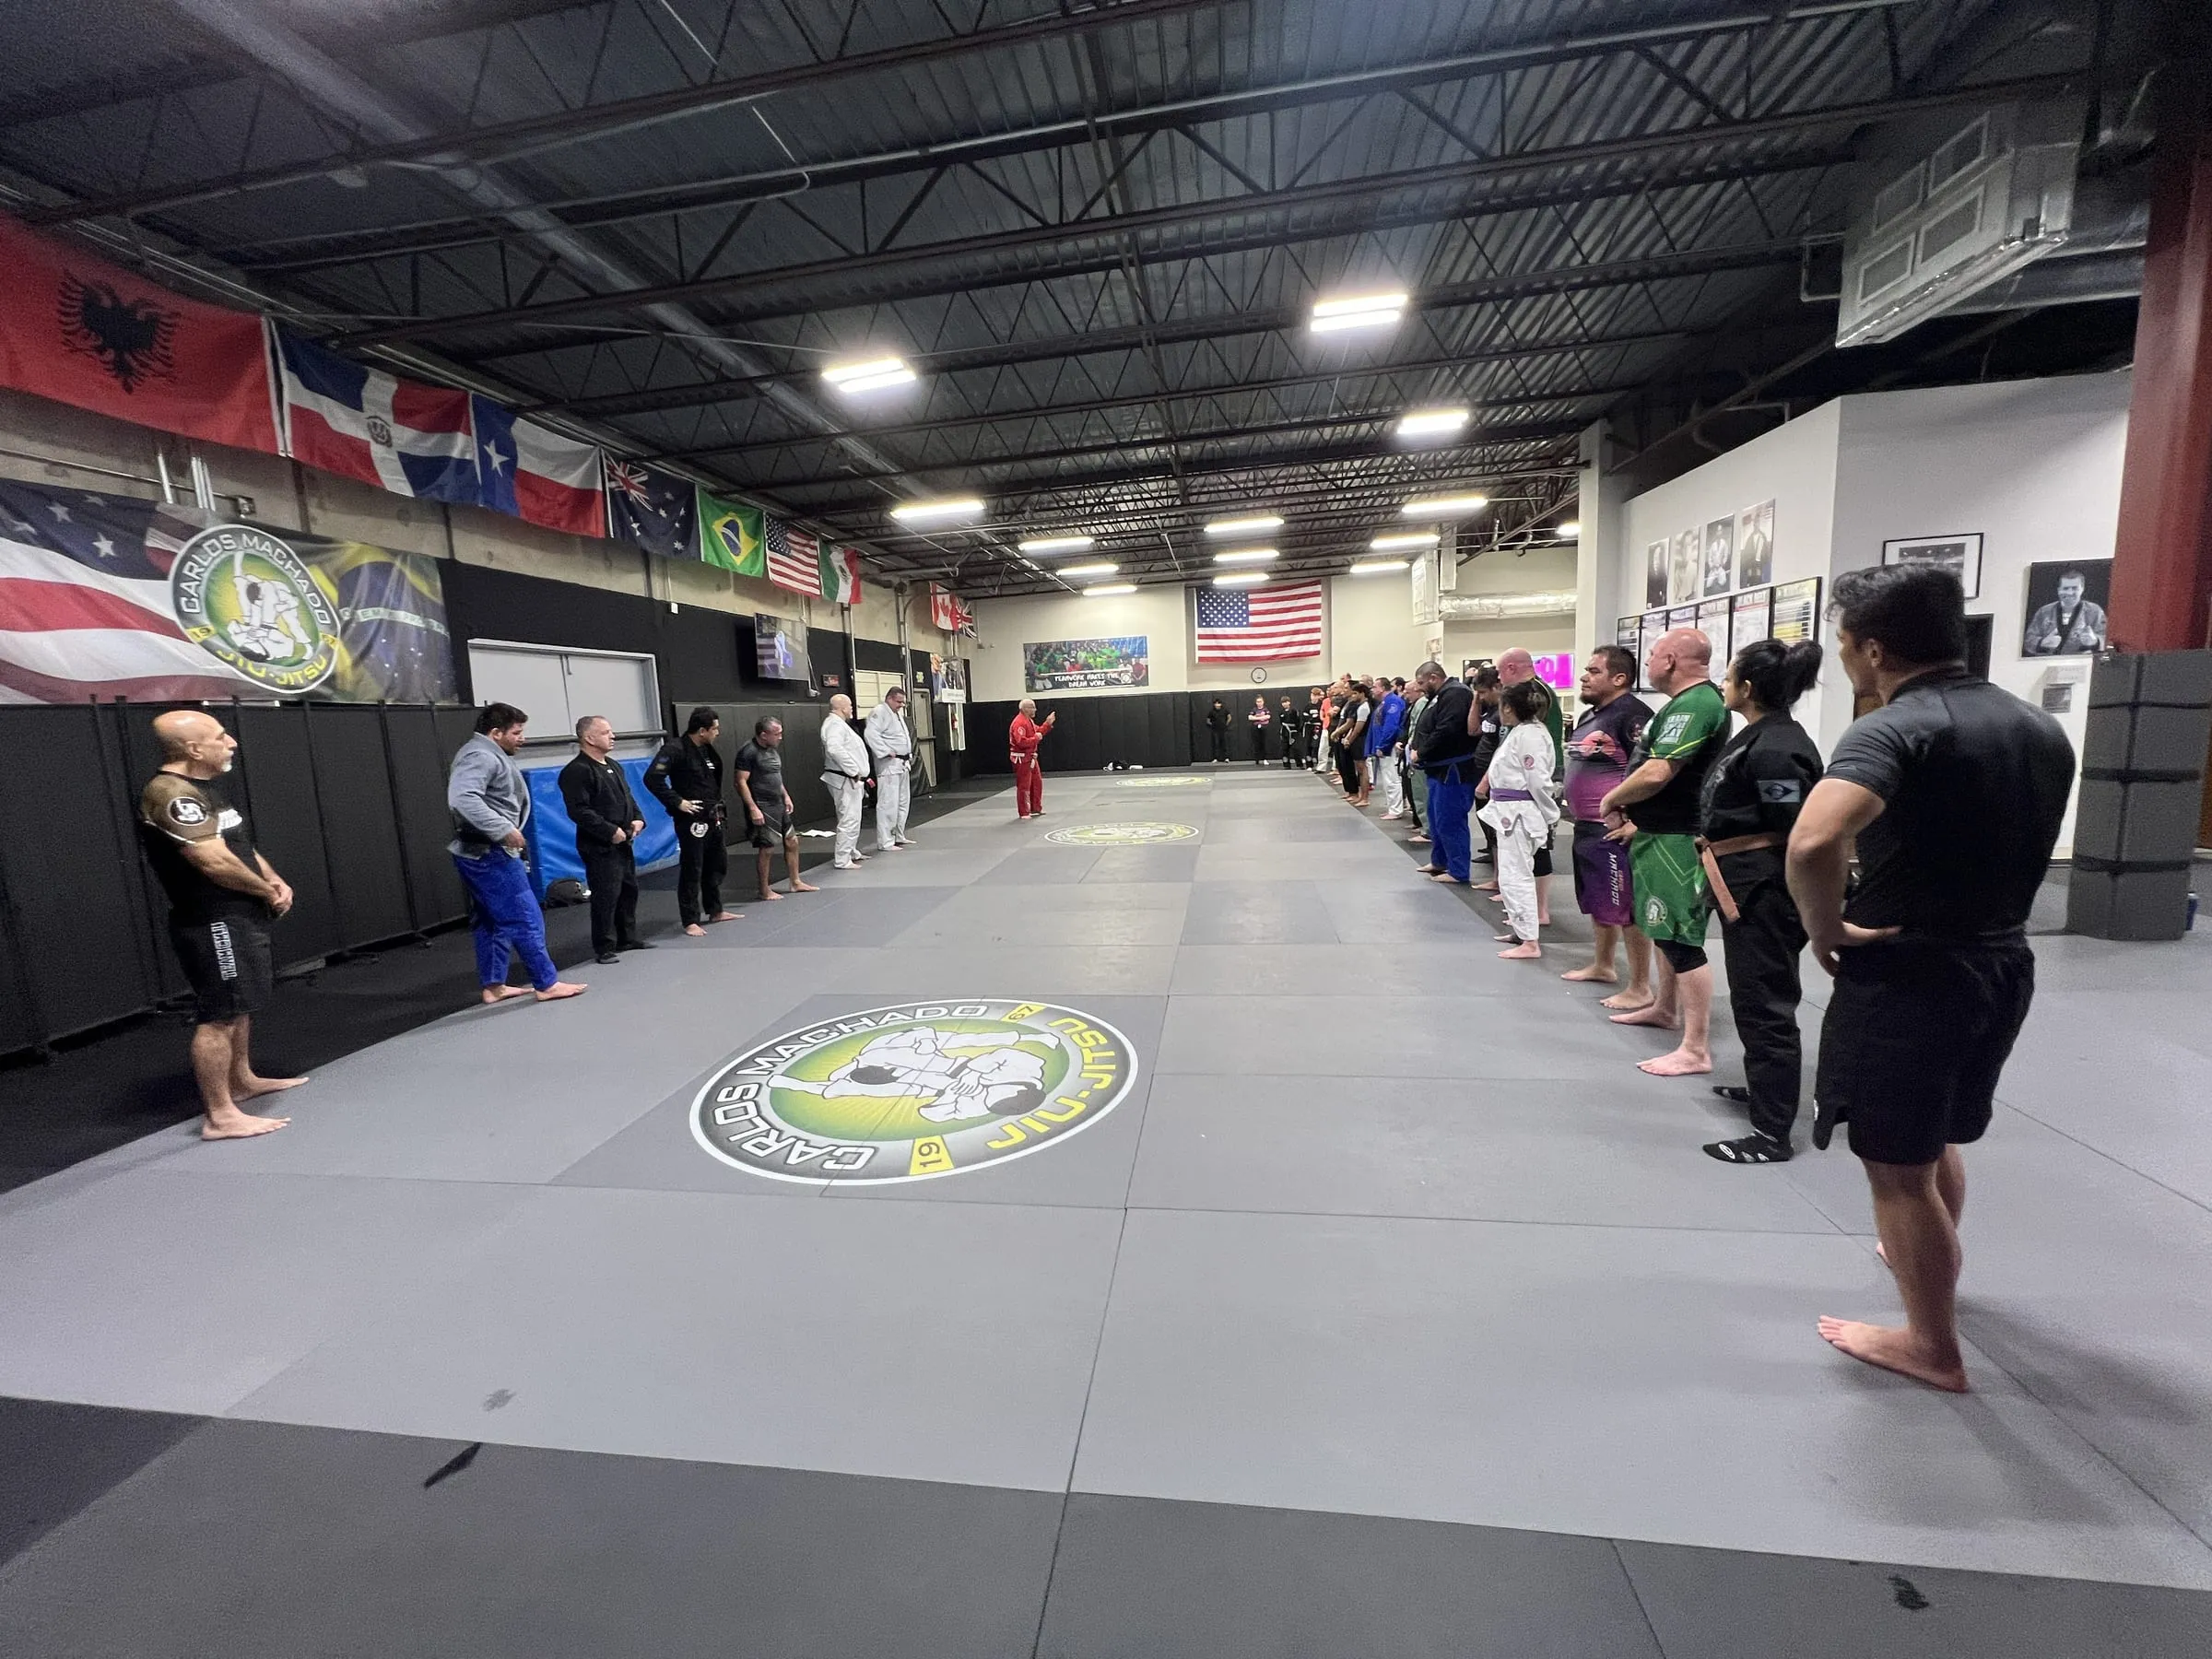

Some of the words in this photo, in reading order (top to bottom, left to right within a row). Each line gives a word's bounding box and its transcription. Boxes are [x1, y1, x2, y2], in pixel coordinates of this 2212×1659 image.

[180, 534, 238, 614] CARLOS
[242, 534, 331, 624] MACHADO
[192, 626, 211, 640] 19
[216, 649, 327, 686] JIU-JITSU
[1607, 852, 1620, 906] MACHADO
[1007, 1005, 1034, 1021] 67
[735, 1006, 989, 1076] MACHADO
[986, 1018, 1116, 1149] JIU-JITSU
[714, 1083, 877, 1171] CARLOS
[917, 1142, 943, 1168] 19
